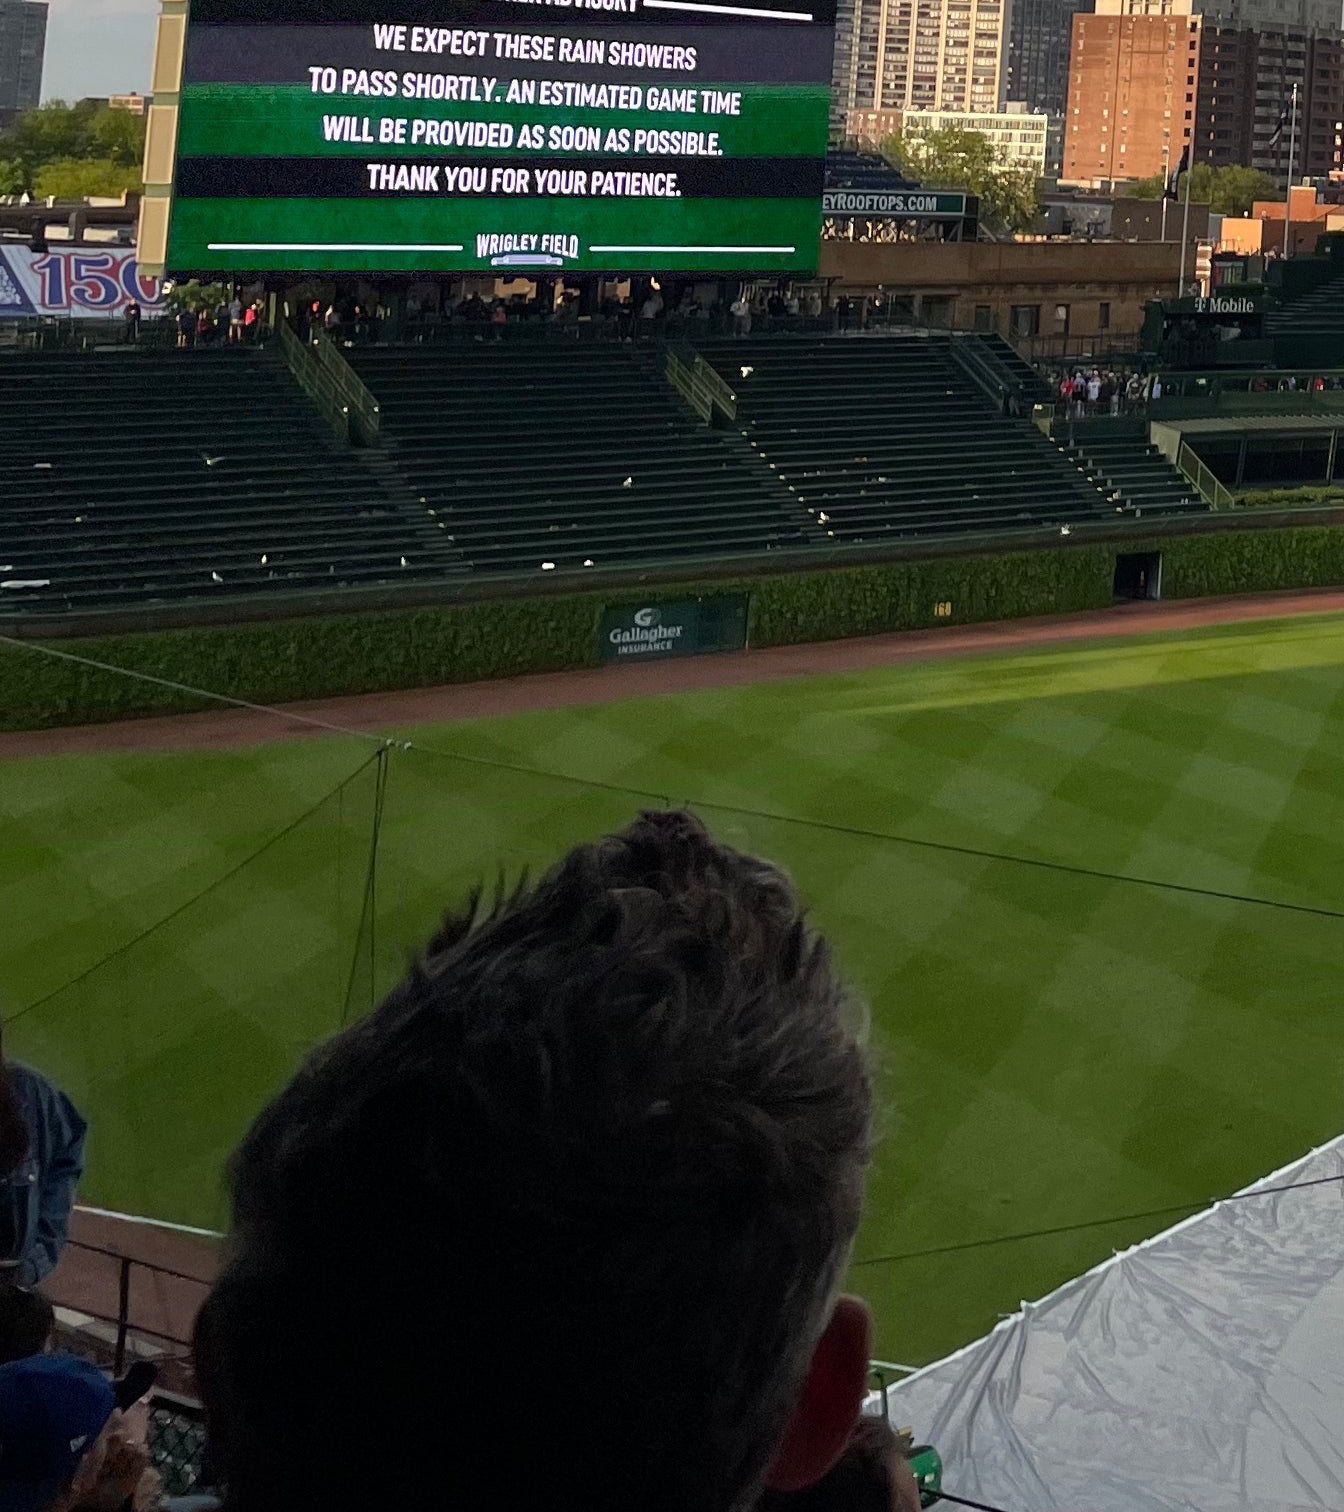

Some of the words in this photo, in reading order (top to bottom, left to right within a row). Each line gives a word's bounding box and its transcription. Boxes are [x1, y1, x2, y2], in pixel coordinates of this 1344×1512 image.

[373, 24, 407, 52] WE
[410, 27, 490, 57] EXPECT
[493, 32, 555, 61] THESE
[558, 38, 605, 64] RAIN
[608, 41, 697, 71] SHOWERS
[308, 66, 337, 94] TO
[341, 69, 398, 97] PASS
[402, 72, 502, 103] SHORTLY.
[505, 79, 535, 105] AN
[539, 81, 642, 110] ESTIMATED
[646, 86, 696, 113] GAME
[700, 90, 741, 115] TIME
[322, 114, 374, 143] WILL
[379, 117, 408, 144] BE
[411, 119, 514, 148] PROVIDED
[516, 124, 545, 150] AS
[548, 125, 601, 152] SOON
[604, 128, 631, 153] AS
[633, 129, 723, 156] POSSIBLE.
[367, 164, 440, 192] THANK
[445, 166, 487, 193] YOU
[490, 168, 530, 194] FOR
[534, 169, 587, 195] YOUR
[590, 171, 682, 197] PATIENCE.
[476, 233, 538, 258] WRIGLEY
[541, 234, 579, 259] FIELD
[1210, 297, 1254, 313] Mobile
[609, 624, 683, 643] Gallagher
[618, 640, 673, 655] INSURANCE
